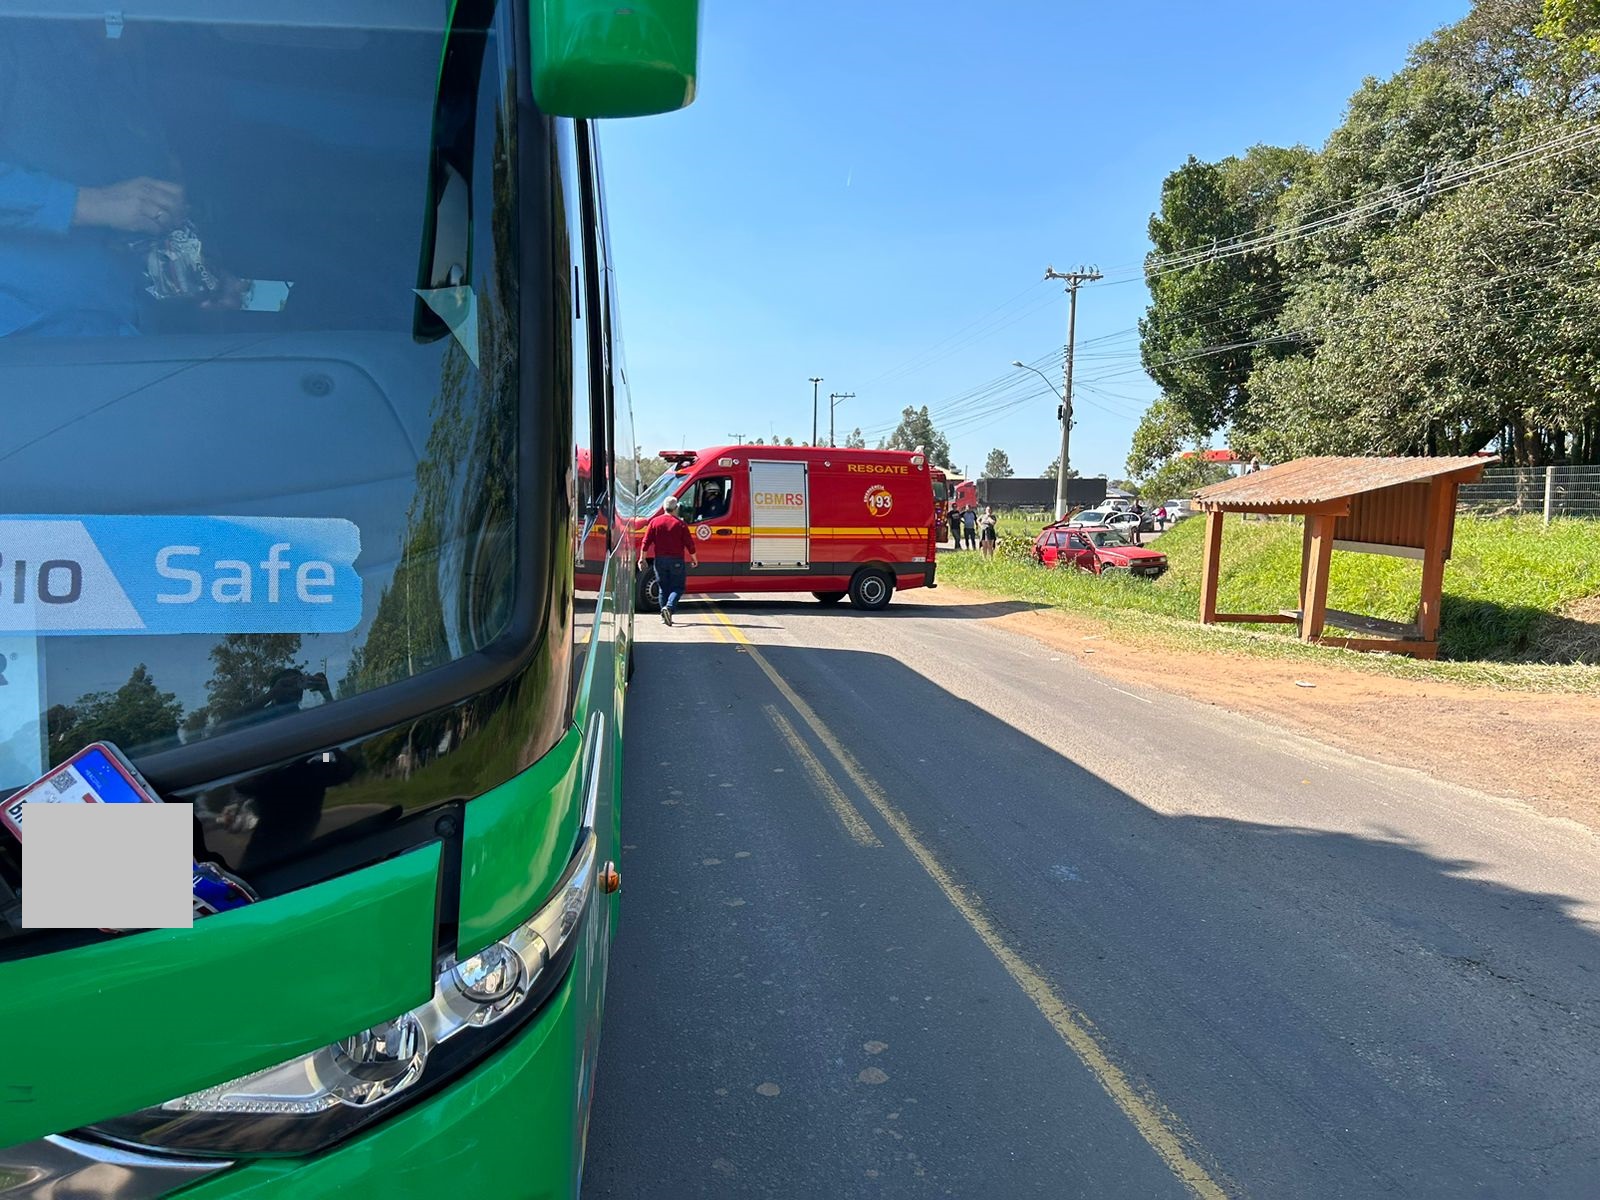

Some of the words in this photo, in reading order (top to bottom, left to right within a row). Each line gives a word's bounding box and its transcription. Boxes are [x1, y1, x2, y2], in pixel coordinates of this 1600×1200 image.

[847, 464, 909, 474] RESGATE
[754, 492, 803, 506] CBMRS
[869, 495, 892, 508] 193
[0, 551, 82, 604] IO
[155, 543, 336, 604] Safe
